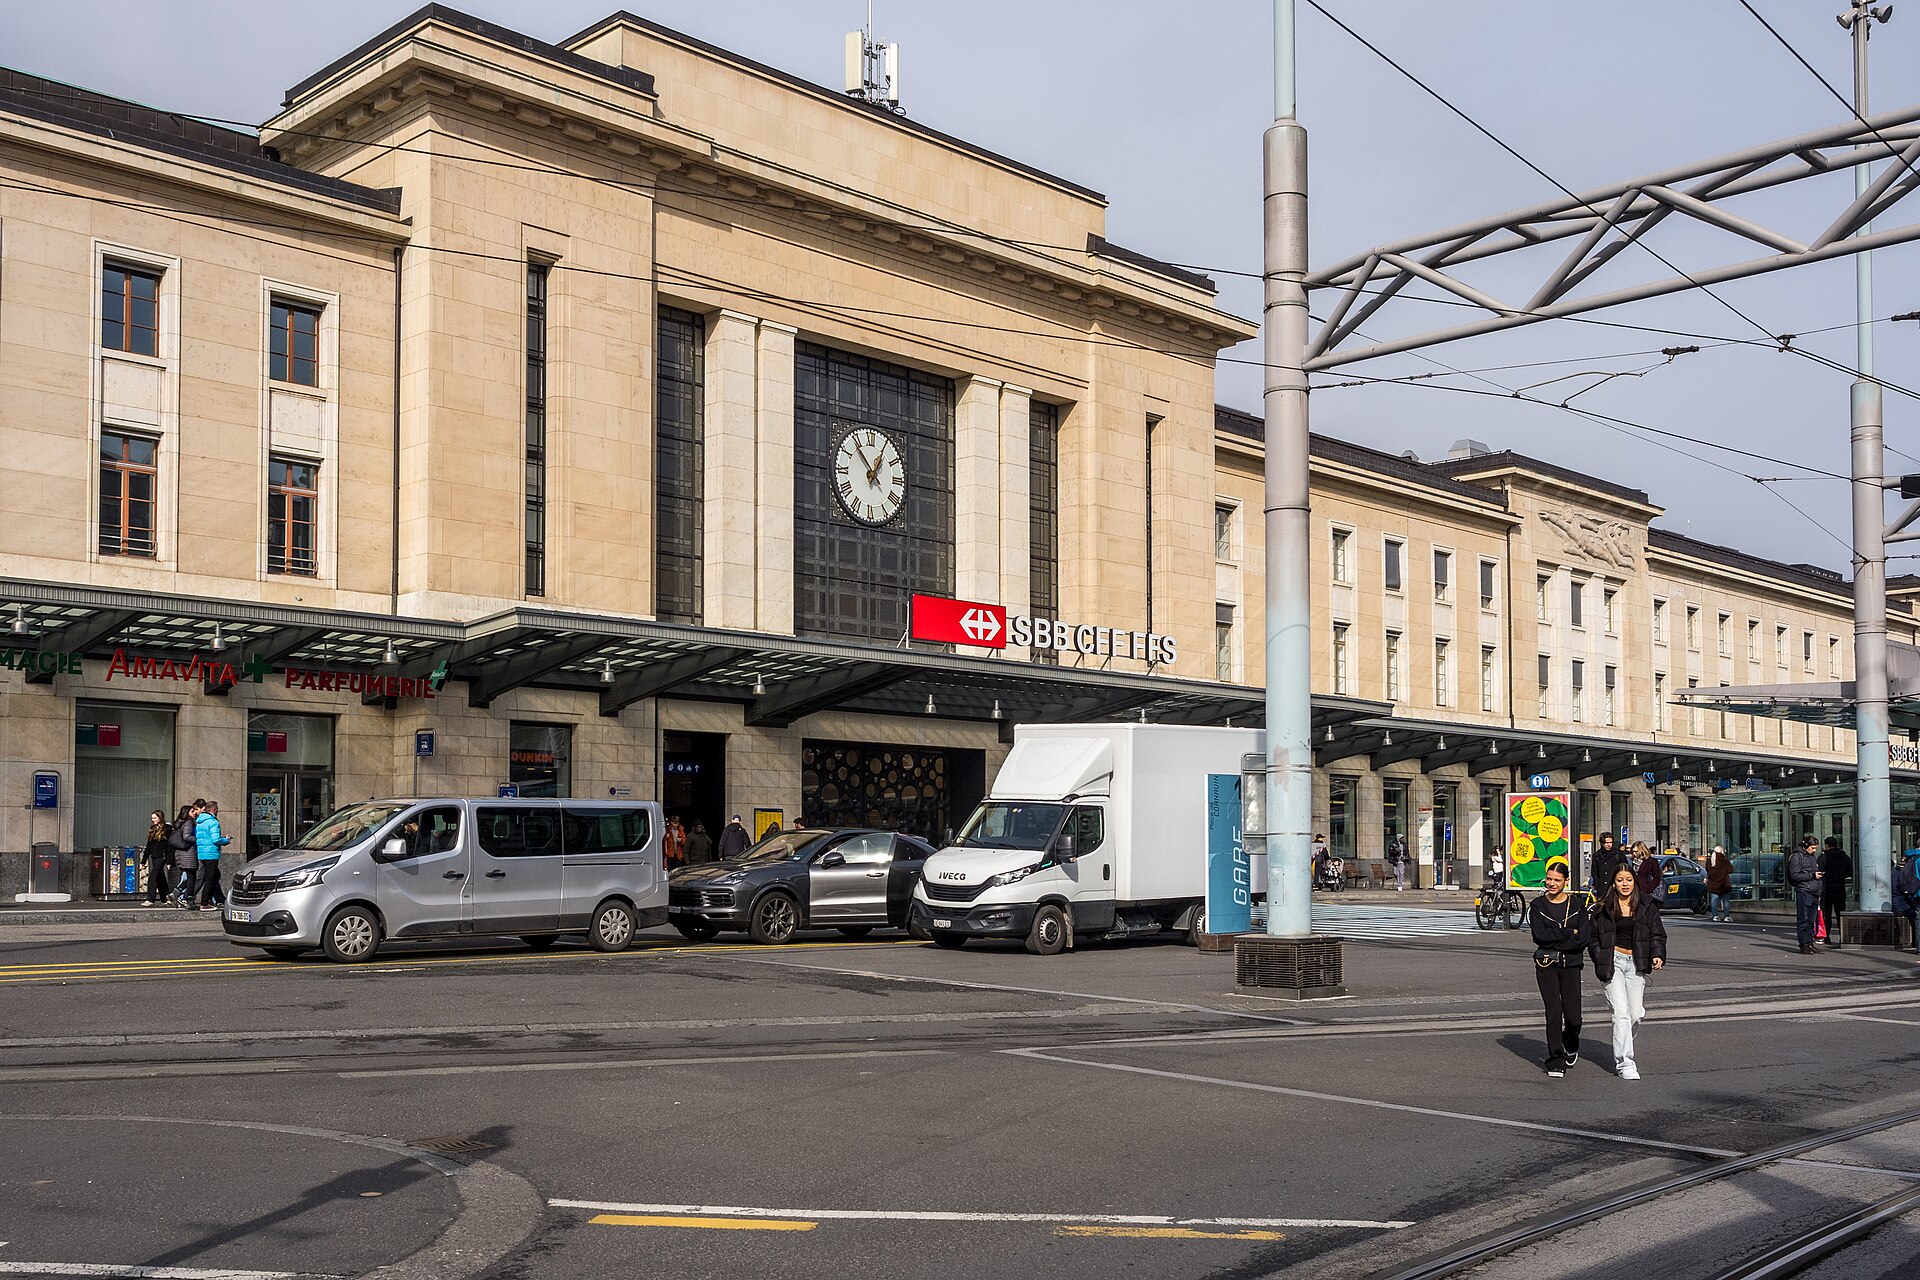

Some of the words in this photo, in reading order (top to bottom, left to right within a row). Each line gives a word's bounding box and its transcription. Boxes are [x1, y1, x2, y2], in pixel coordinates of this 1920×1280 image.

[1012, 616, 1069, 650] SBB
[1074, 624, 1125, 656] CFF
[1130, 631, 1177, 664] FFS
[106, 648, 238, 685] AMAVITA
[285, 668, 436, 699] PARFUMERIE
[1891, 745, 1908, 761] SBB
[1642, 772, 1655, 783] CSS
[255, 796, 277, 807] 20%
[938, 871, 967, 881] IVECO
[1233, 825, 1248, 906] GARE
